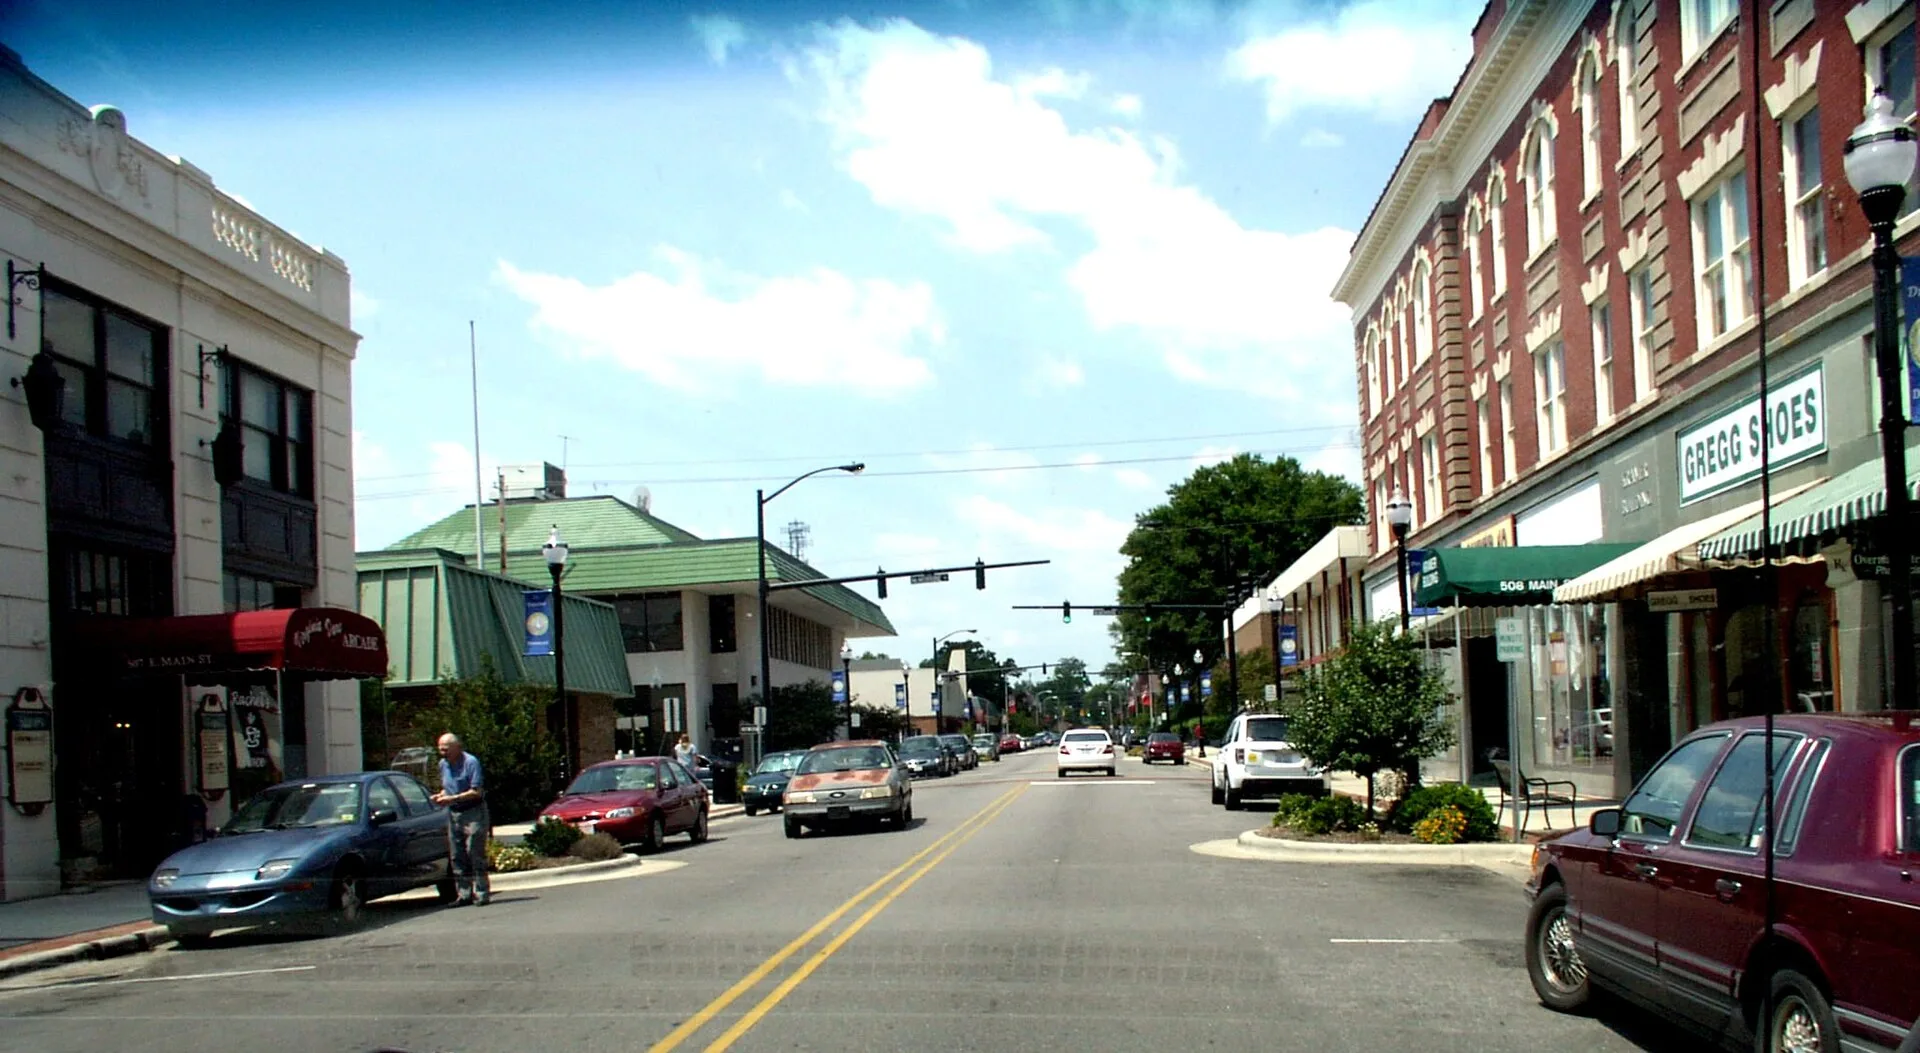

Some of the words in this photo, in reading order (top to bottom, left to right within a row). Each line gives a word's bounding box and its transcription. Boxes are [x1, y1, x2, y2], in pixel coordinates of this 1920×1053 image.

[1685, 423, 1742, 484] GREGG
[1749, 387, 1817, 458] SHOES
[1500, 580, 1525, 592] 508
[1528, 579, 1558, 591] MAIN
[342, 633, 379, 651] ARCADE
[160, 655, 195, 667] MAIN
